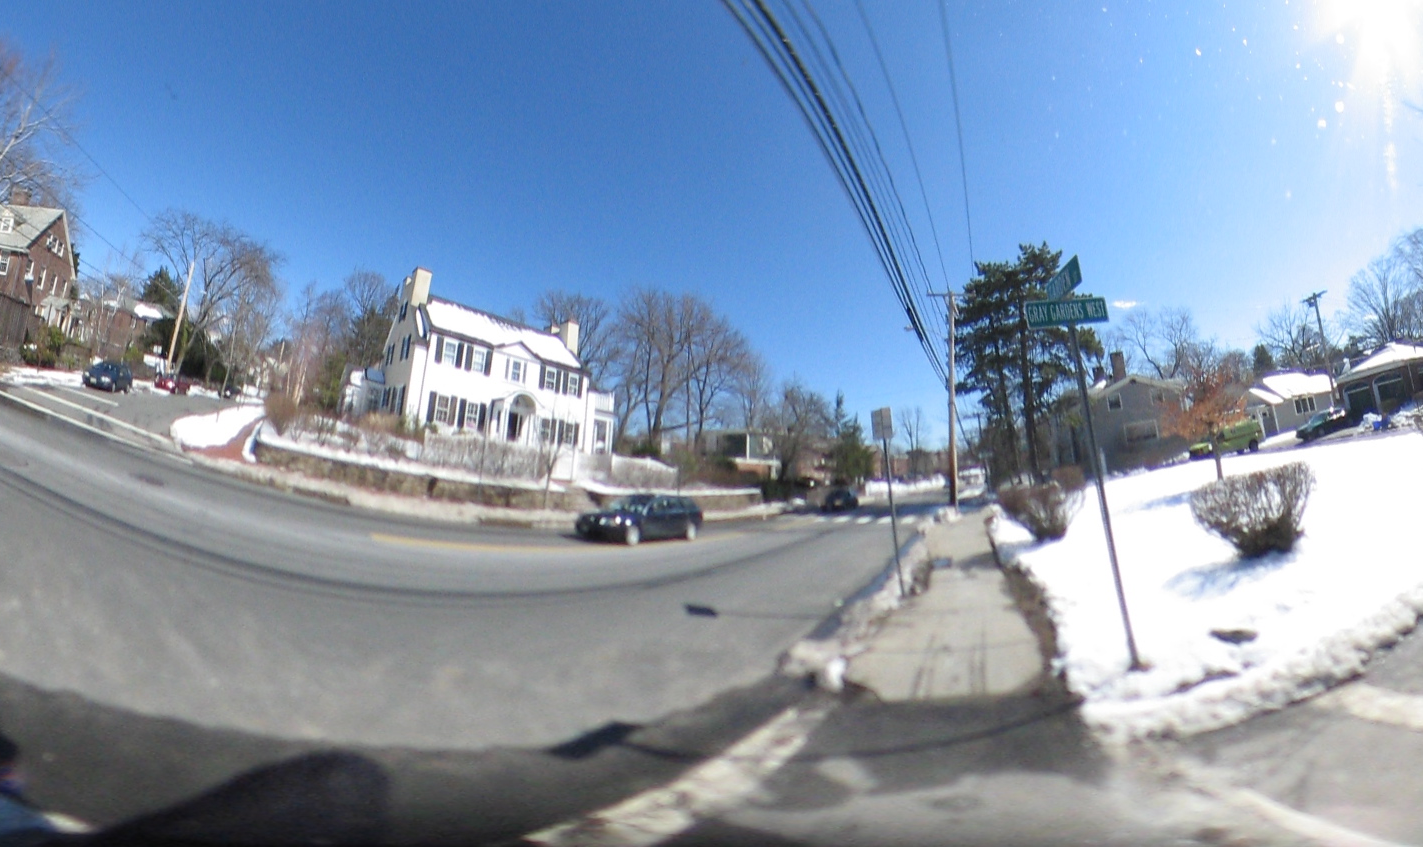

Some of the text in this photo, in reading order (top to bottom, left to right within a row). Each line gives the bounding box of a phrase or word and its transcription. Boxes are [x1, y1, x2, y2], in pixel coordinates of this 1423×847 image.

[1028, 301, 1105, 323] GRAY GARDENS WEST
